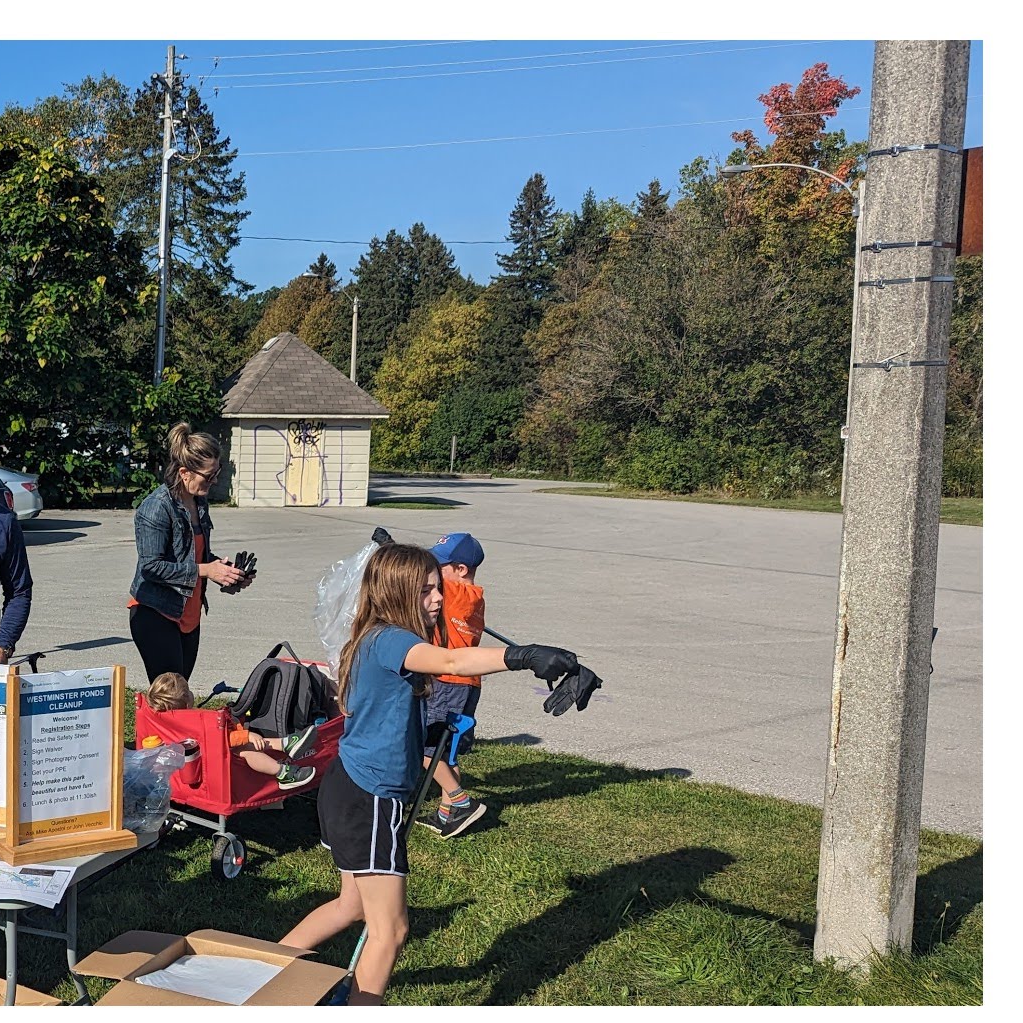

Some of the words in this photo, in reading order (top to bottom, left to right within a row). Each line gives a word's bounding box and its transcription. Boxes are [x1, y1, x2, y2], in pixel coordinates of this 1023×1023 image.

[27, 690, 79, 703] WESTMINSTER
[80, 689, 105, 698] PONDS
[49, 700, 83, 711] CLEANUP
[52, 714, 80, 723] Welcome!
[40, 724, 74, 734] Registration
[75, 722, 91, 731] Steps
[32, 736, 47, 744] Read
[56, 733, 73, 741] Safety
[32, 748, 44, 756] Sign
[45, 754, 77, 763] Photography
[72, 775, 85, 783] park
[32, 787, 56, 796] beautiful
[31, 799, 48, 807] Lunch
[50, 818, 78, 826] Questions?
[48, 826, 66, 834] Apostol
[85, 820, 103, 828] Vecchio
